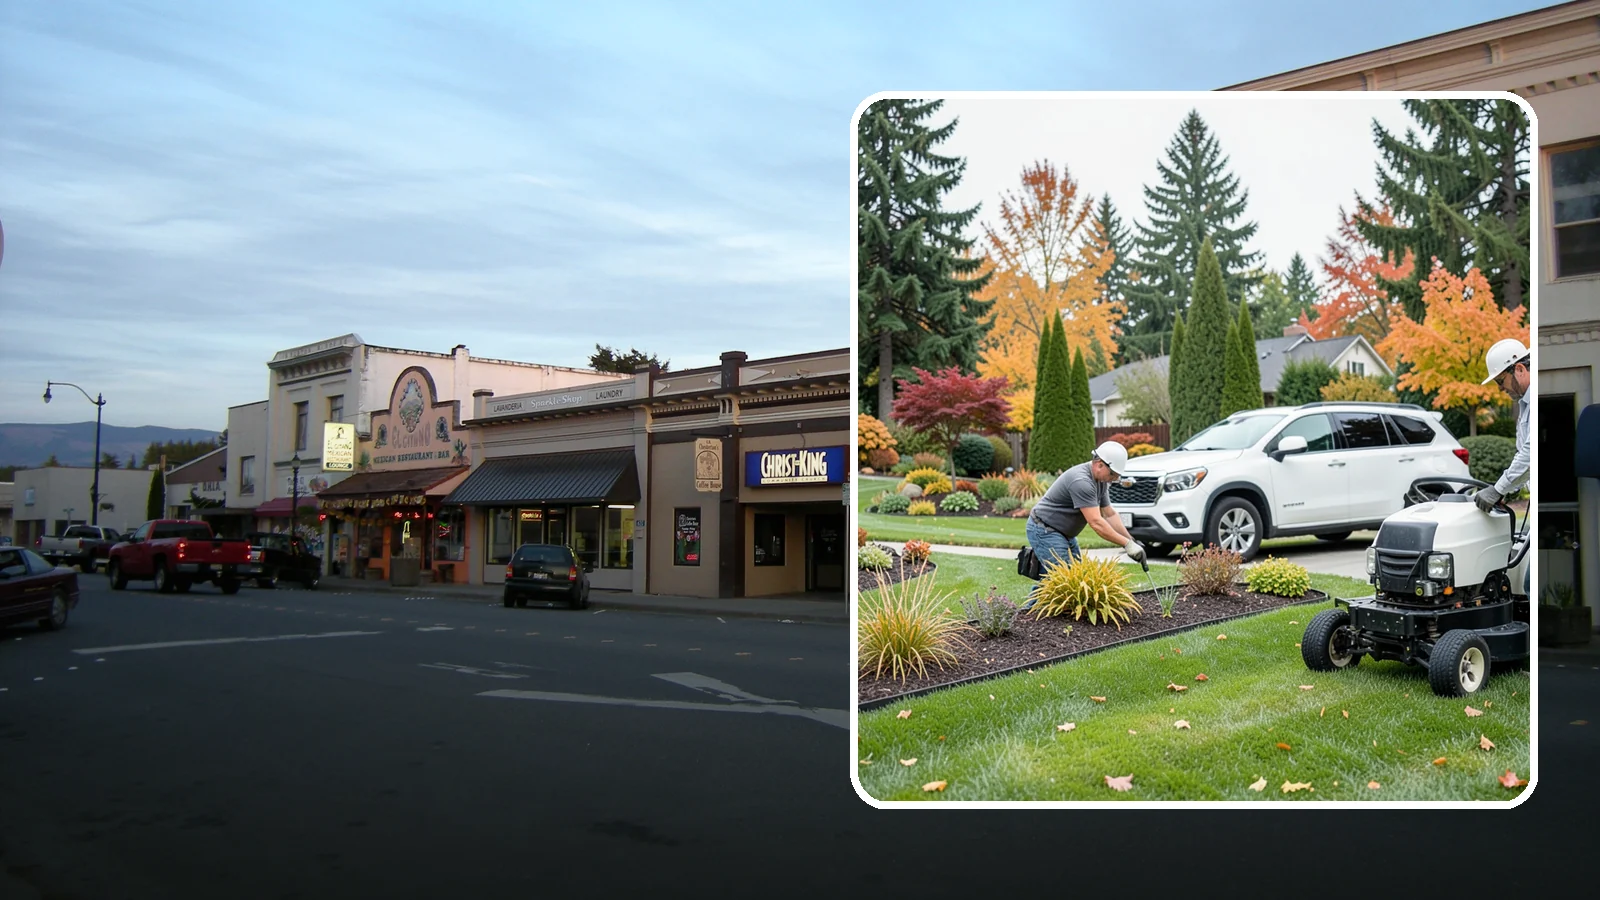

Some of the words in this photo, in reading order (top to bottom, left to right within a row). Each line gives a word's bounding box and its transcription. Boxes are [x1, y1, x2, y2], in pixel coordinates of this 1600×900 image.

[530, 398, 561, 409] Sparkle
[562, 394, 582, 405] Shop
[595, 389, 623, 400] LAUNDRY
[493, 402, 522, 412] LAVANDERIA
[373, 455, 396, 464] MEXICAN
[397, 451, 433, 462] RESTAURANT
[437, 449, 450, 458] BAR
[761, 453, 795, 477] CHRIST
[798, 450, 827, 475] KING
